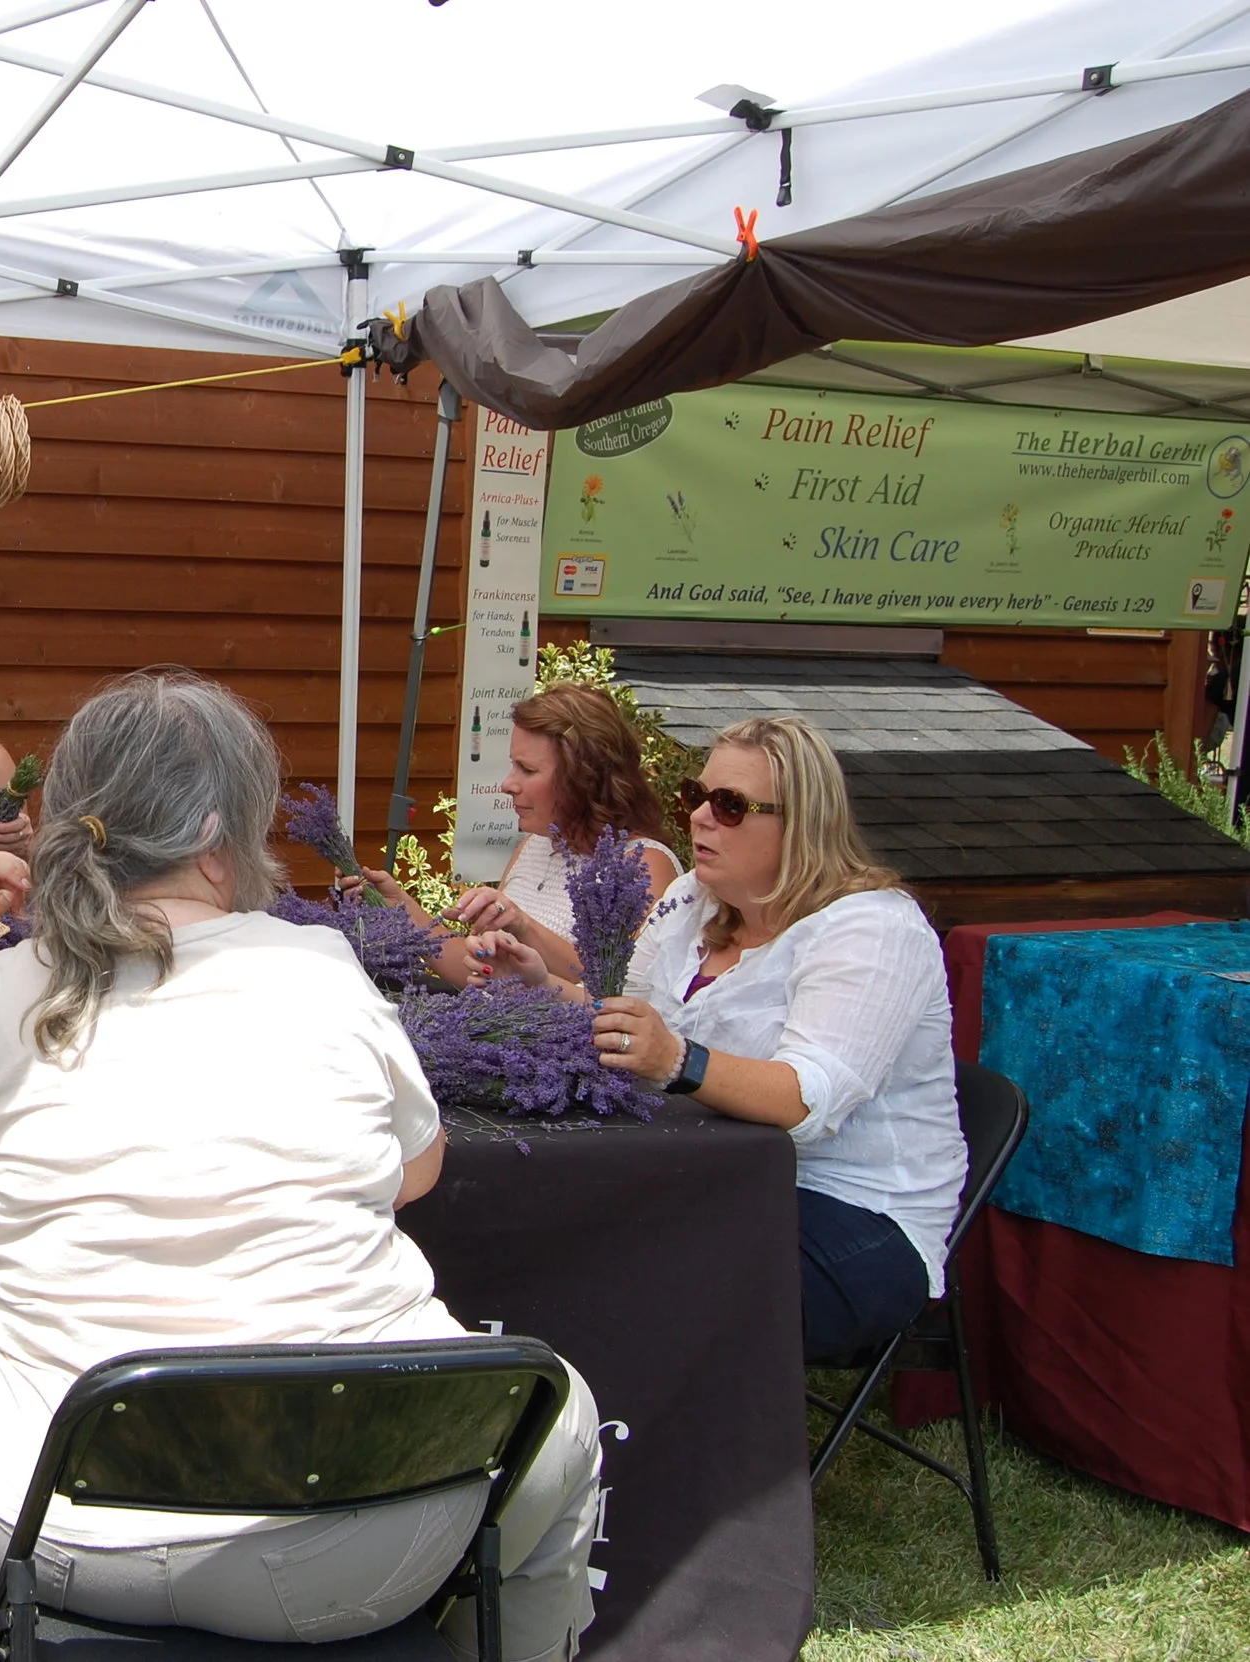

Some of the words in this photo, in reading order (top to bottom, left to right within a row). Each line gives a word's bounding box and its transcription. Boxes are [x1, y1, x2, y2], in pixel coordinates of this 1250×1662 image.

[484, 409, 530, 437] Pain
[619, 421, 630, 432] in
[583, 432, 630, 451] Southern
[631, 415, 668, 442] Oregon
[761, 407, 834, 445] Pain
[841, 412, 935, 458] Relief
[1016, 430, 1051, 452] The
[1058, 430, 1145, 458] Herbal
[1149, 441, 1207, 462] Gerbil
[482, 444, 545, 477] Relief
[1018, 462, 1191, 486] www.theherbalgerbil.com
[788, 467, 862, 503] First
[865, 472, 926, 506] Aid
[480, 492, 540, 506] Arnica-Plus+
[496, 516, 510, 527] for
[511, 516, 539, 528] Muscle
[1049, 511, 1122, 537] Organic
[1123, 513, 1191, 536] Herbal
[496, 533, 531, 544] Soreness
[814, 525, 880, 560] Skin
[889, 530, 960, 564] Care
[1074, 539, 1151, 561] Products
[473, 588, 537, 602] Frankincense
[646, 583, 684, 601] And
[688, 583, 725, 602] God
[728, 585, 768, 605] said,
[821, 588, 830, 605] I
[832, 588, 872, 606] have
[876, 590, 922, 609] given
[925, 594, 955, 611] you
[959, 594, 1001, 612] every
[1063, 594, 1119, 613] Genesis
[1122, 597, 1155, 613] 1:29
[472, 610, 485, 622] for
[486, 611, 515, 622] Hands,
[480, 627, 515, 638] Tendons
[496, 644, 515, 654] Skin
[470, 687, 495, 700] Joint
[497, 687, 529, 700] Relief
[486, 710, 500, 721] for
[486, 726, 510, 737] Joints
[493, 797, 516, 810] Reli
[472, 821, 486, 833] for
[488, 820, 513, 833] Rapid
[486, 836, 512, 847] Relief
